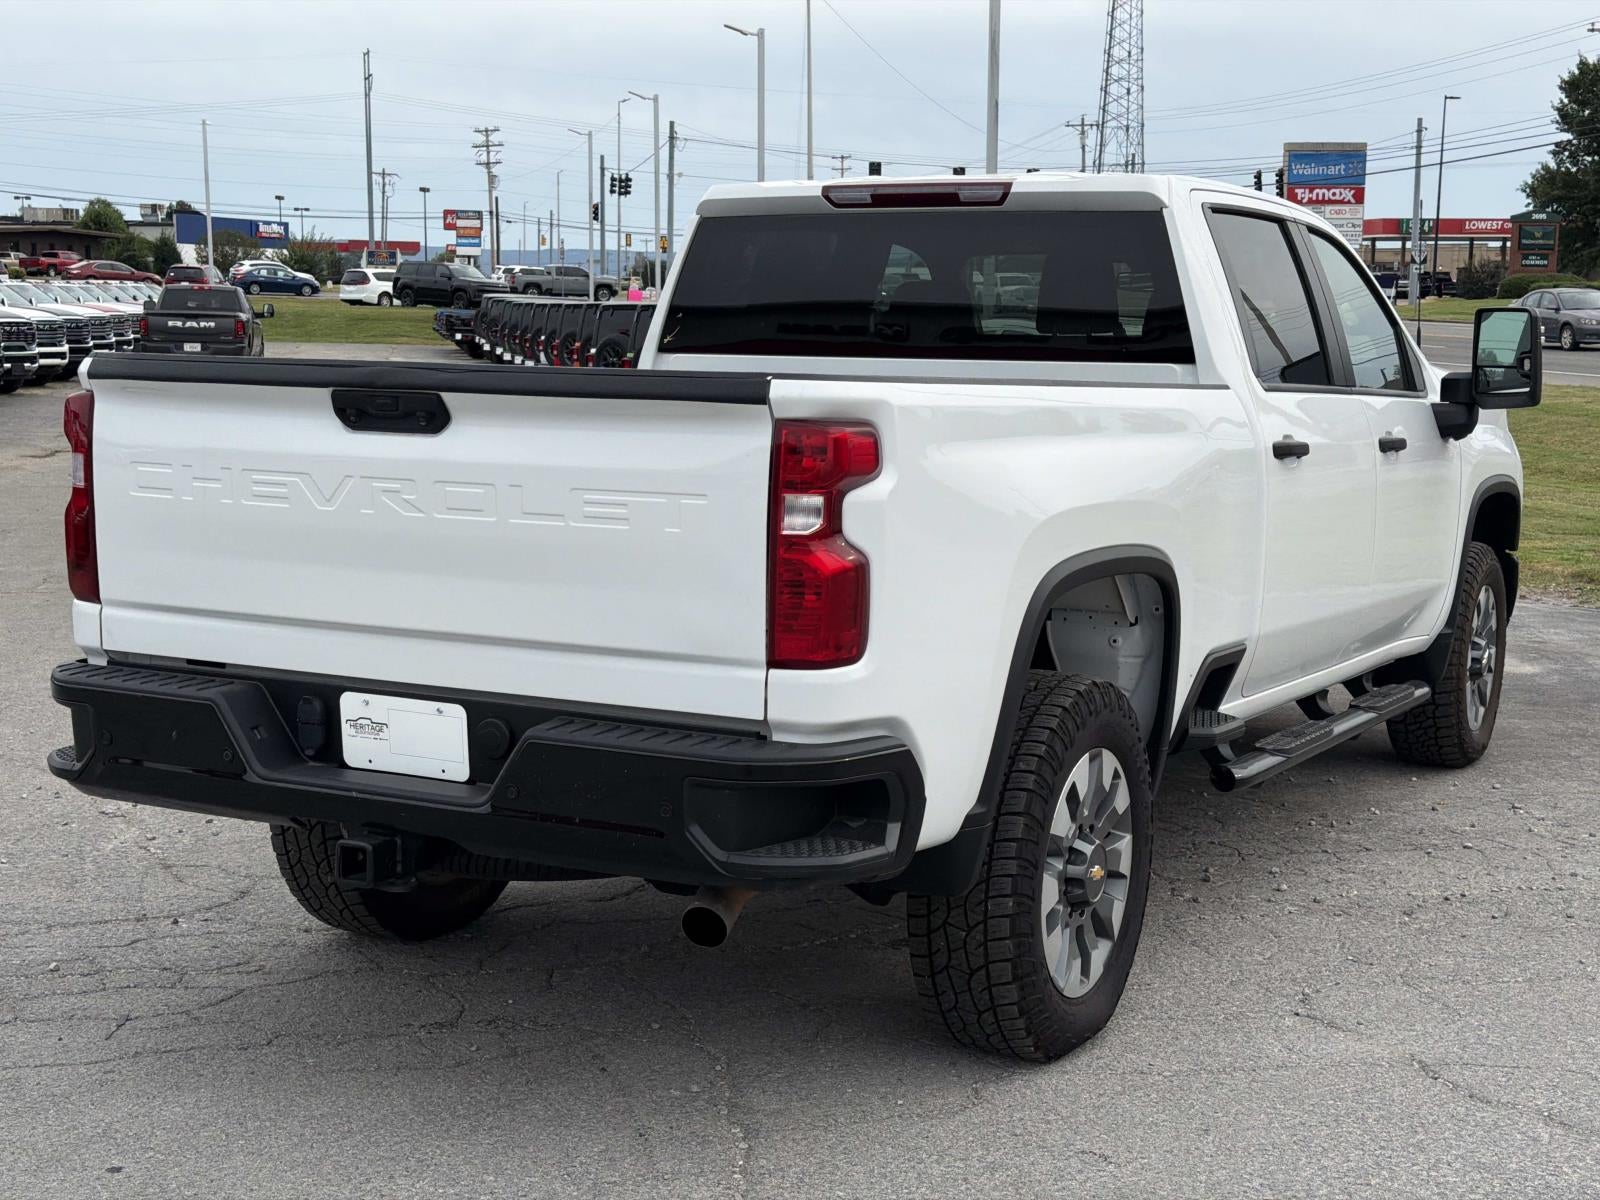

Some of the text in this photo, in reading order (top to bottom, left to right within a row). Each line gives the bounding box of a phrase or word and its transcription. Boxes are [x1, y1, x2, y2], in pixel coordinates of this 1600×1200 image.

[1292, 162, 1345, 175] Walmart
[1465, 220, 1503, 230] LOWEST
[167, 320, 216, 328] RAM
[128, 459, 709, 533] CHEVROLET
[349, 722, 385, 733] HERITAGE
